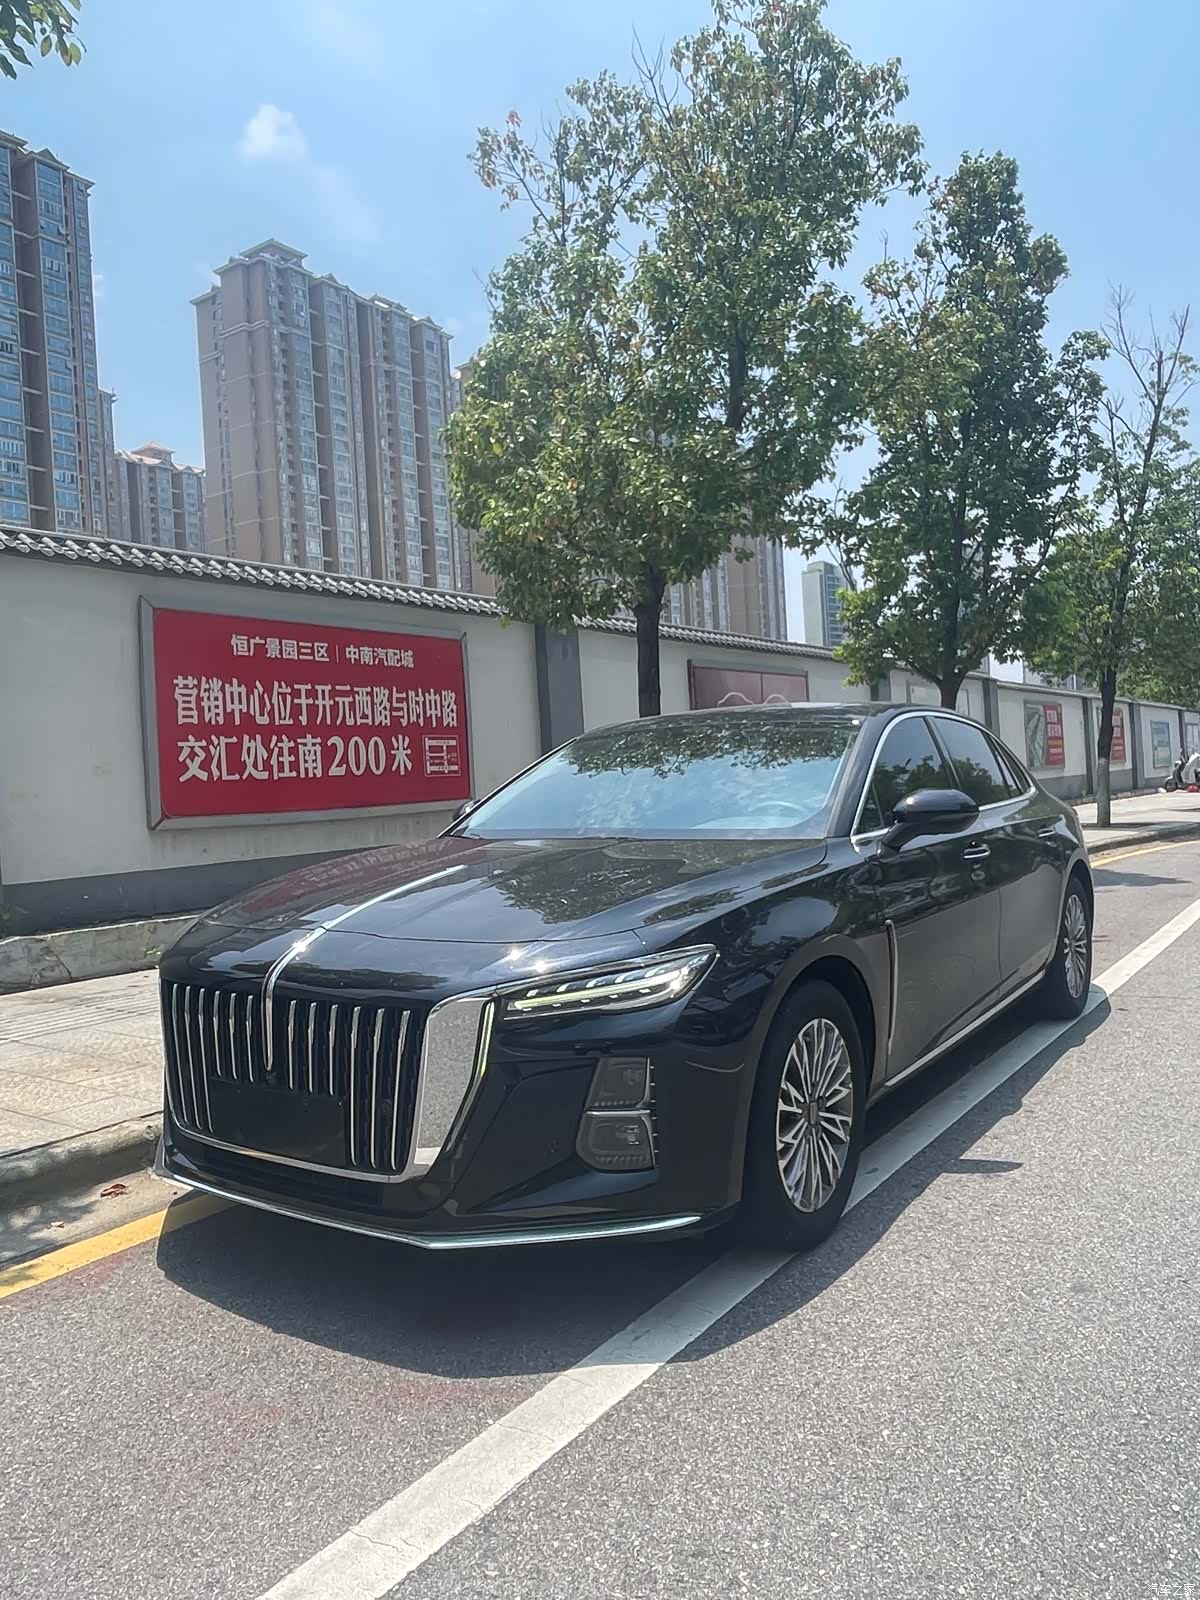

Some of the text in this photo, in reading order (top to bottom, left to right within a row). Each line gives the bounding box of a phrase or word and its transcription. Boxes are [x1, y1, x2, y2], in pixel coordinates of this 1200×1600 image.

[231, 634, 415, 668] 恒广景园三区 中南汽配城
[173, 675, 457, 727] 营销中心位于开元西路与时中路
[177, 733, 412, 782] 交汇处往南200米
